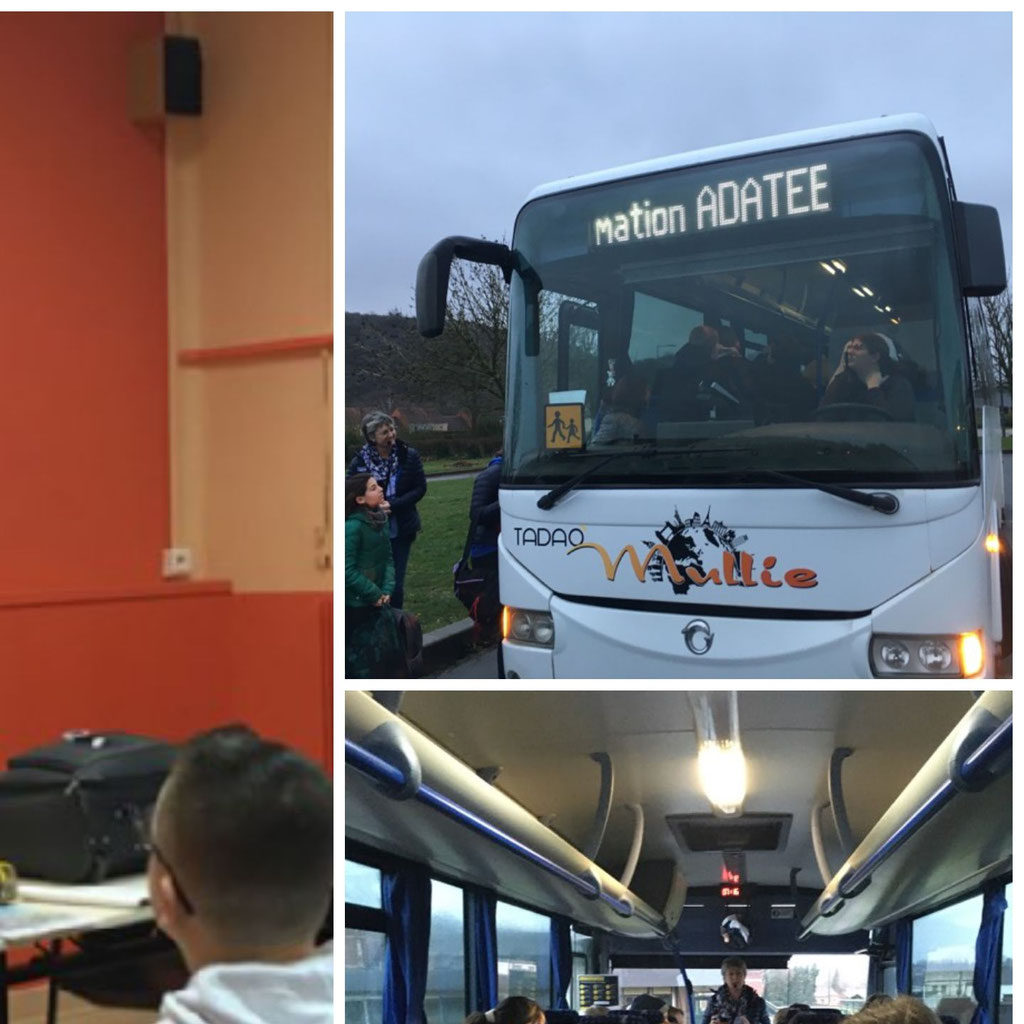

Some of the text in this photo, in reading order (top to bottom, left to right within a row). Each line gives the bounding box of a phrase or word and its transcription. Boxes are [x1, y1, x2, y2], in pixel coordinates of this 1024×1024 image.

[594, 163, 830, 246] mation ADATEE
[513, 527, 585, 547] TADAO
[566, 542, 819, 588] Mullie
